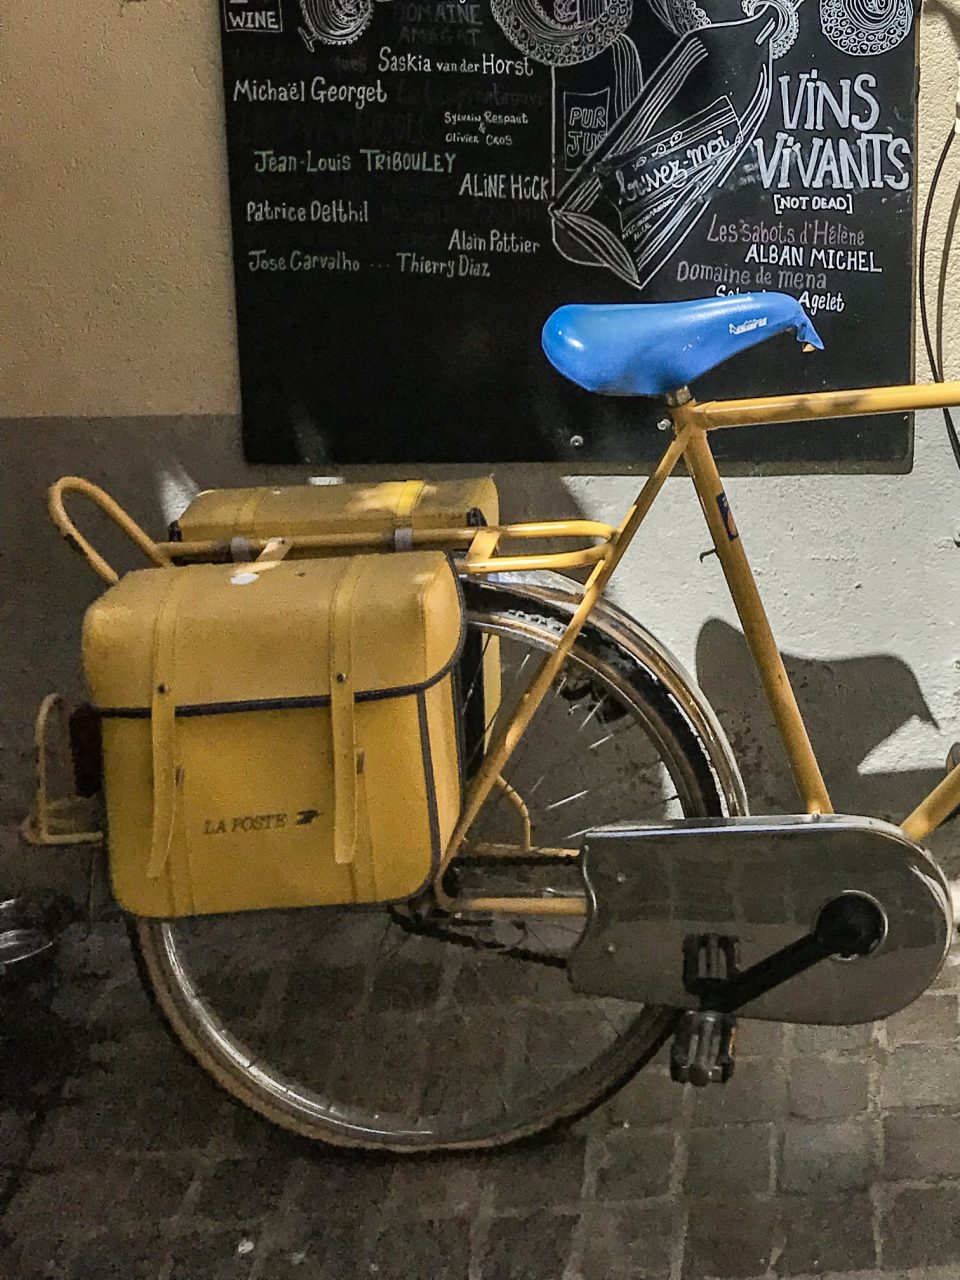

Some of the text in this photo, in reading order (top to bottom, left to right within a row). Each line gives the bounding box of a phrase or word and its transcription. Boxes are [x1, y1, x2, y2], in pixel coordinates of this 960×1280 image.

[228, 11, 279, 29] WINE
[437, 60, 458, 72] van
[460, 54, 481, 73] der
[482, 54, 534, 76] Horst
[232, 79, 306, 103] Michaël
[310, 76, 388, 109] Georget
[569, 106, 606, 128] PUR
[247, 200, 368, 222] Patrice Delthil
[706, 213, 738, 243] Les
[448, 229, 486, 252] Alain
[290, 250, 361, 271] Carvalho
[397, 252, 490, 277] Thierry Diaz
[744, 243, 883, 273] ALBAN MICHEL
[676, 260, 750, 285] Domaine
[755, 265, 772, 285] de
[798, 291, 845, 316] Agelet
[203, 813, 288, 835] LA POSTE
